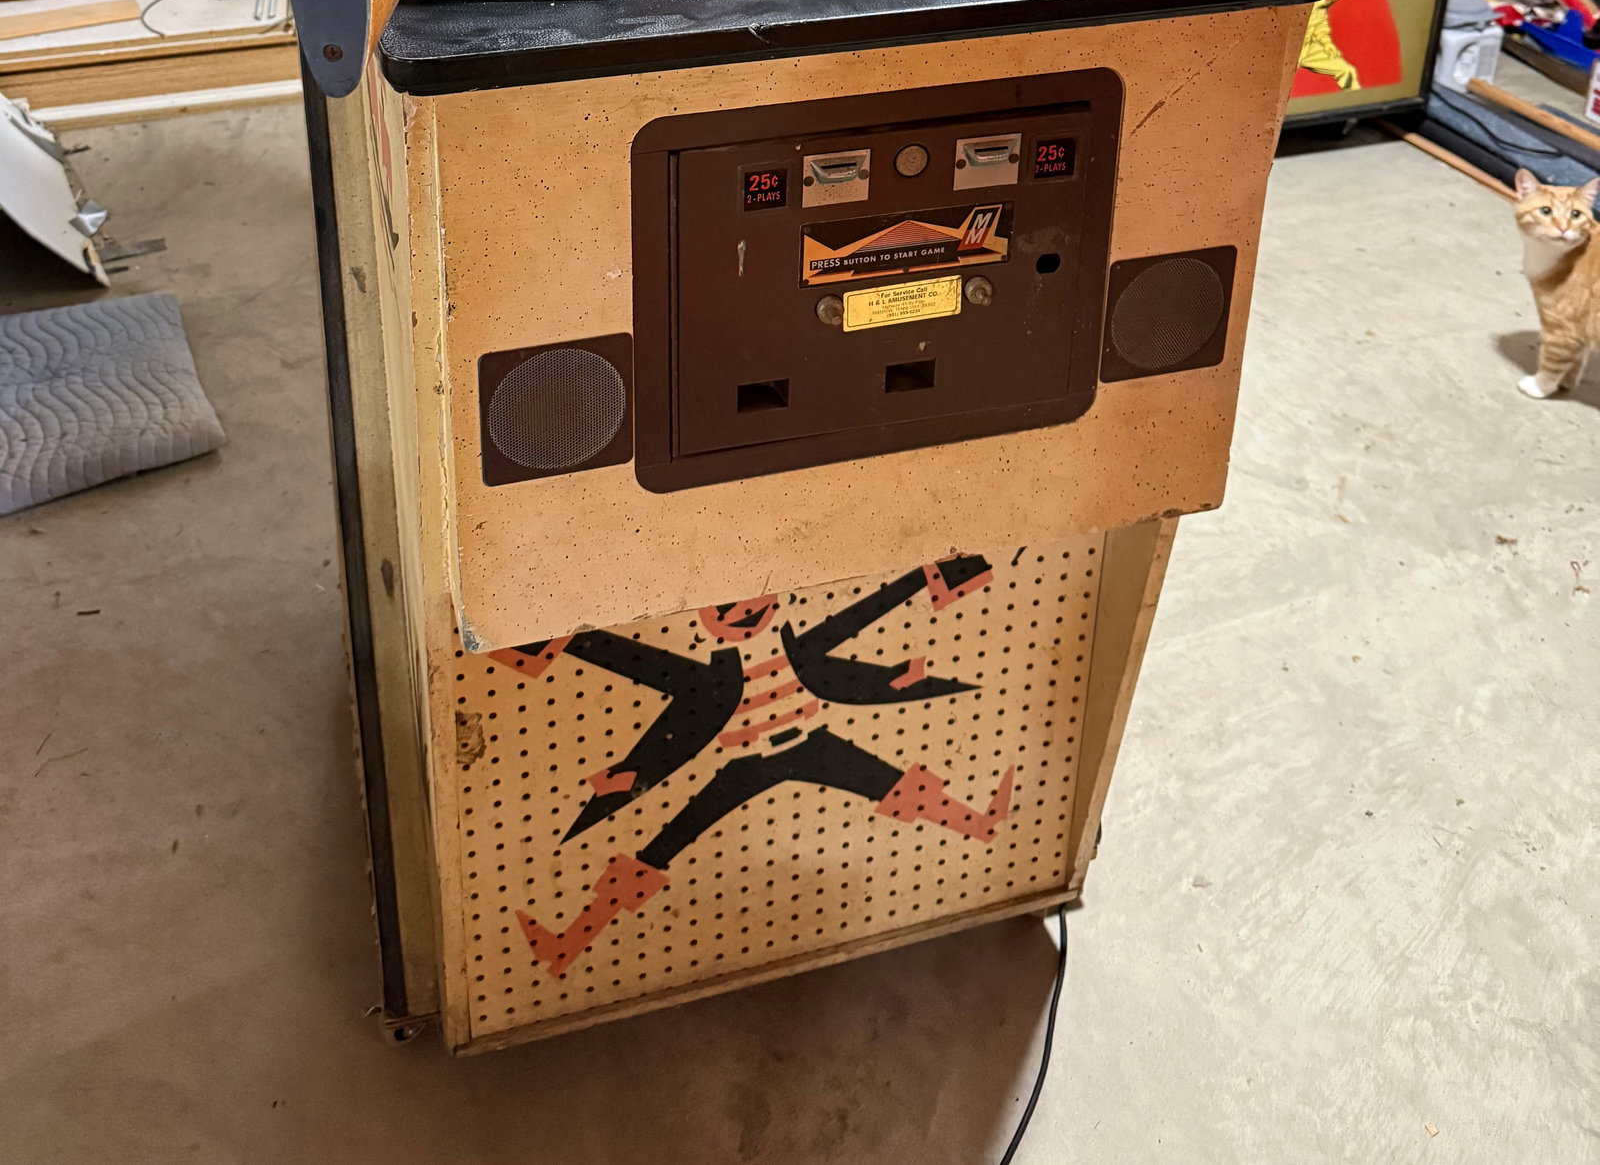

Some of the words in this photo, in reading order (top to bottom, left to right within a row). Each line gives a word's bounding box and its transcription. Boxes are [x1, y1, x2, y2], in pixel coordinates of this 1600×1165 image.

[1037, 145, 1065, 162] 25¢
[748, 174, 779, 192] 25¢
[811, 258, 841, 270] PRESS
[843, 256, 877, 266] BUTTON
[880, 254, 891, 262] TO
[893, 250, 919, 260] START
[921, 246, 945, 256] GAME
[887, 292, 927, 304] AMUSEMENT
